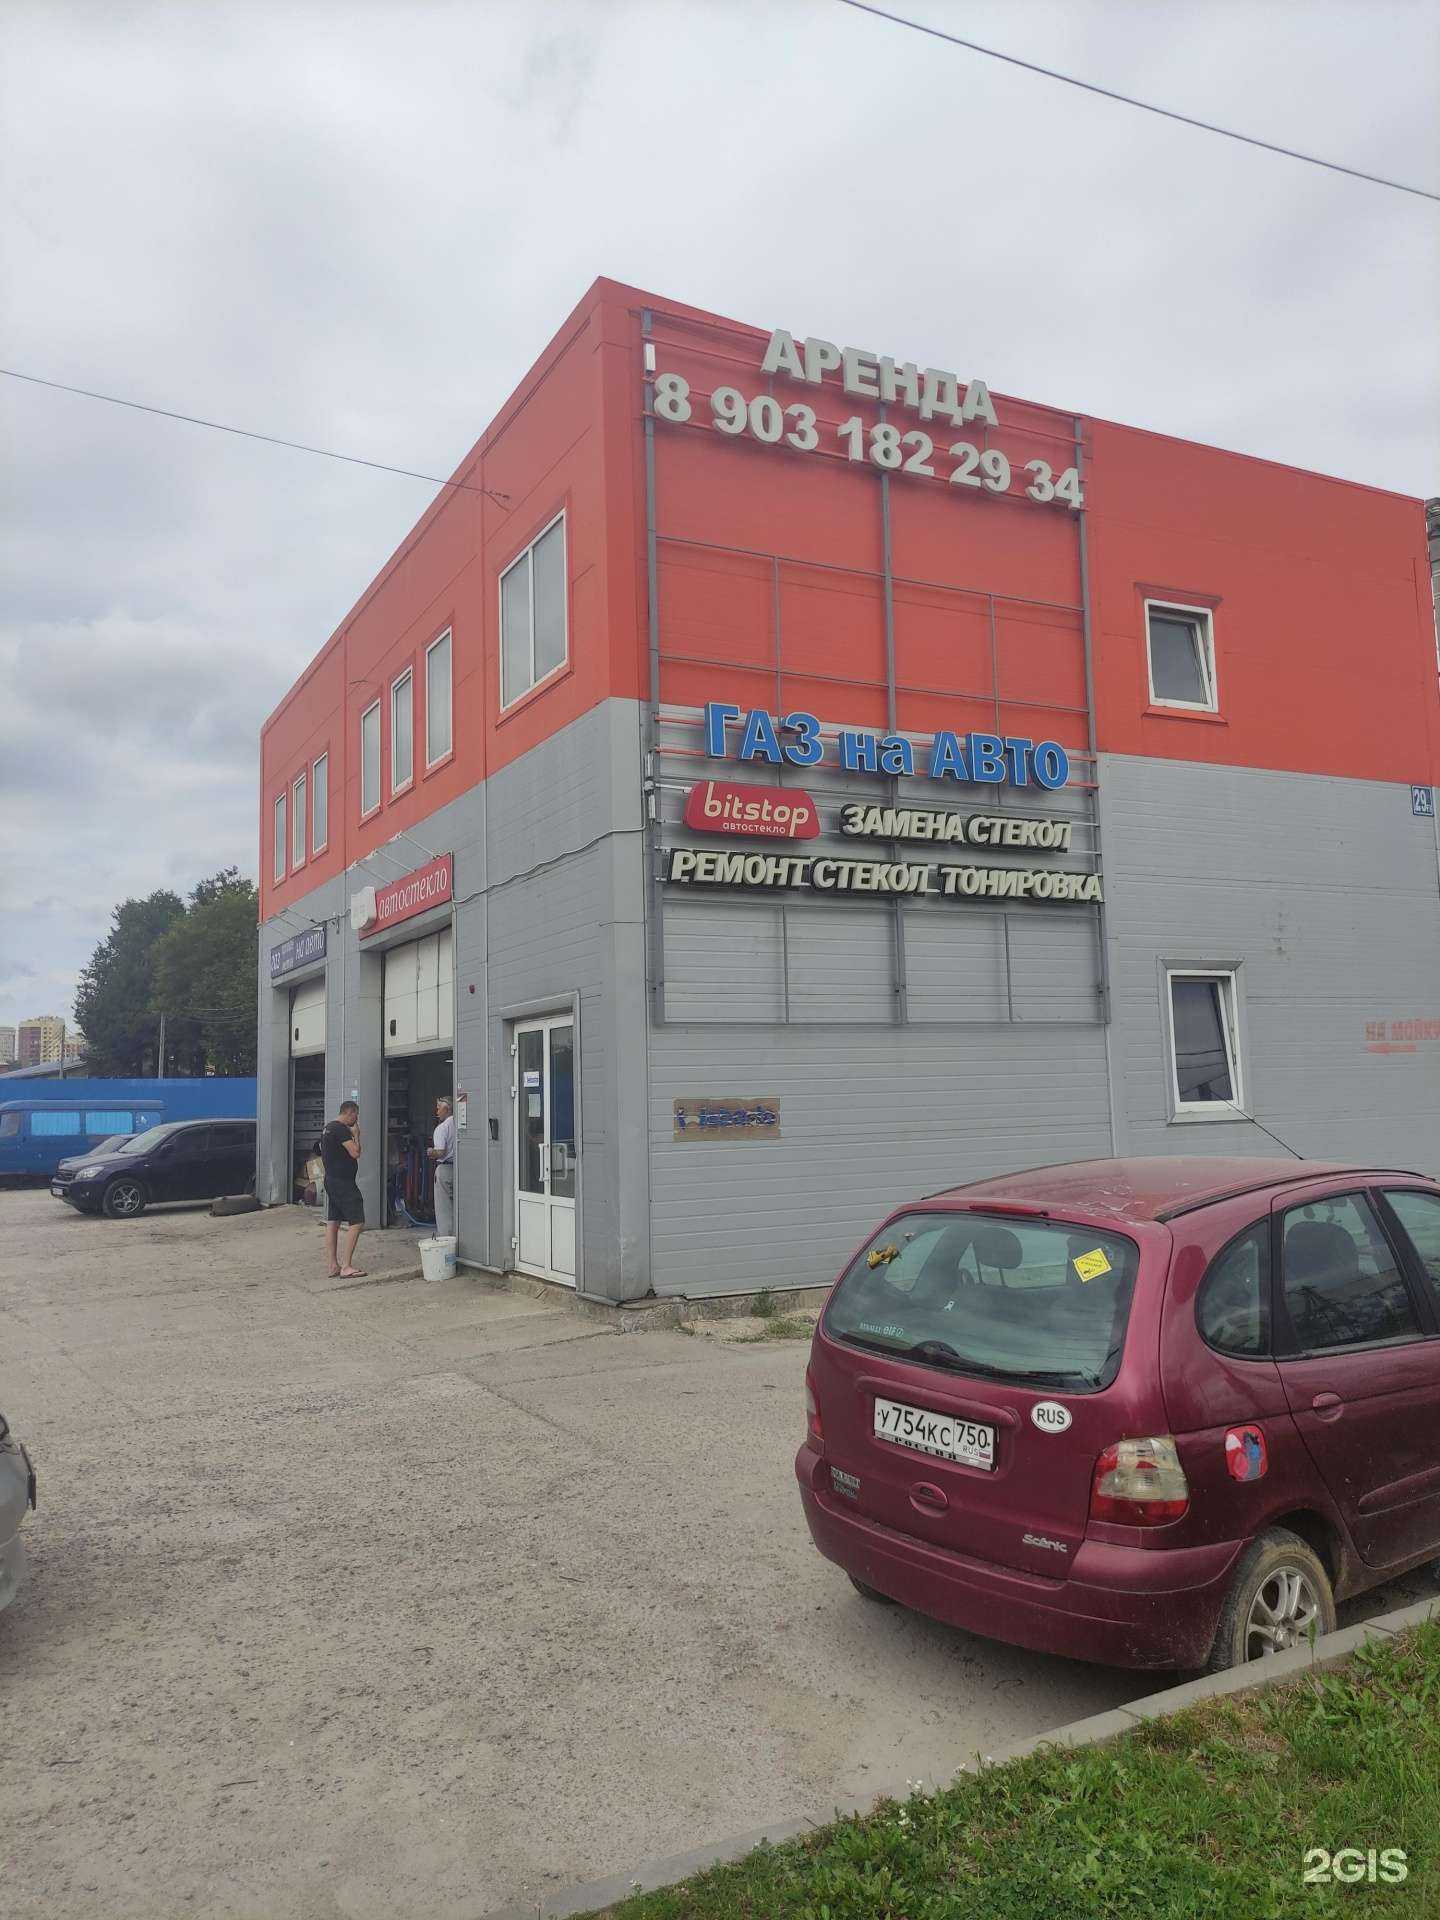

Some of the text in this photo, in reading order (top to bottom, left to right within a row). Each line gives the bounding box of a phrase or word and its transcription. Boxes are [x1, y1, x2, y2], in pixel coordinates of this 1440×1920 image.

[761, 328, 999, 427] АРЕНДА
[654, 373, 1085, 510] 8 903 182 29 34
[704, 702, 1071, 791] ГАЗ на АВТО
[704, 781, 809, 838] bitstop
[722, 821, 786, 834] автостекло
[841, 804, 1072, 851] ЗАМЕНА СТЕКОЛ
[379, 868, 448, 920] автостекло
[671, 850, 1104, 903] РЕМОНТ СТЕКОЛ ТОНИРОВКА
[1036, 1407, 1066, 1426] RUS
